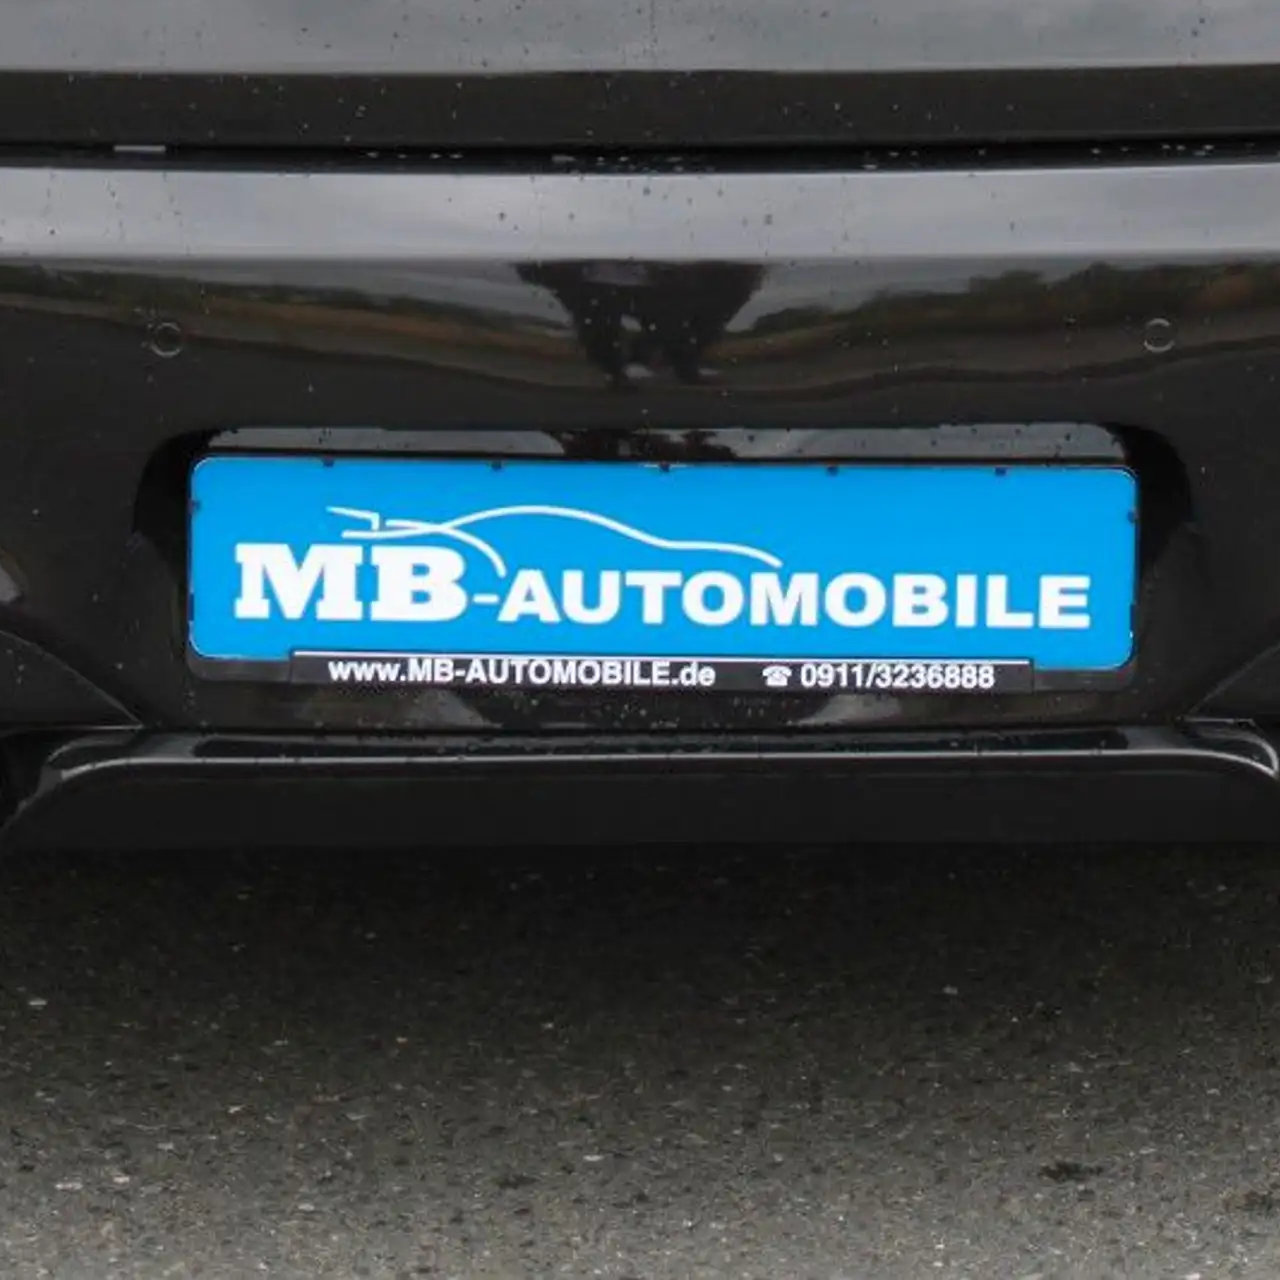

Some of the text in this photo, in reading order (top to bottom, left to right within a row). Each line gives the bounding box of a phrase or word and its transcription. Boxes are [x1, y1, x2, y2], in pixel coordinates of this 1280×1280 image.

[234, 543, 1092, 629] MB-AUTOMOBILE
[328, 659, 995, 689] www.MB-AUTOMOBILE.de 0911/3236888
